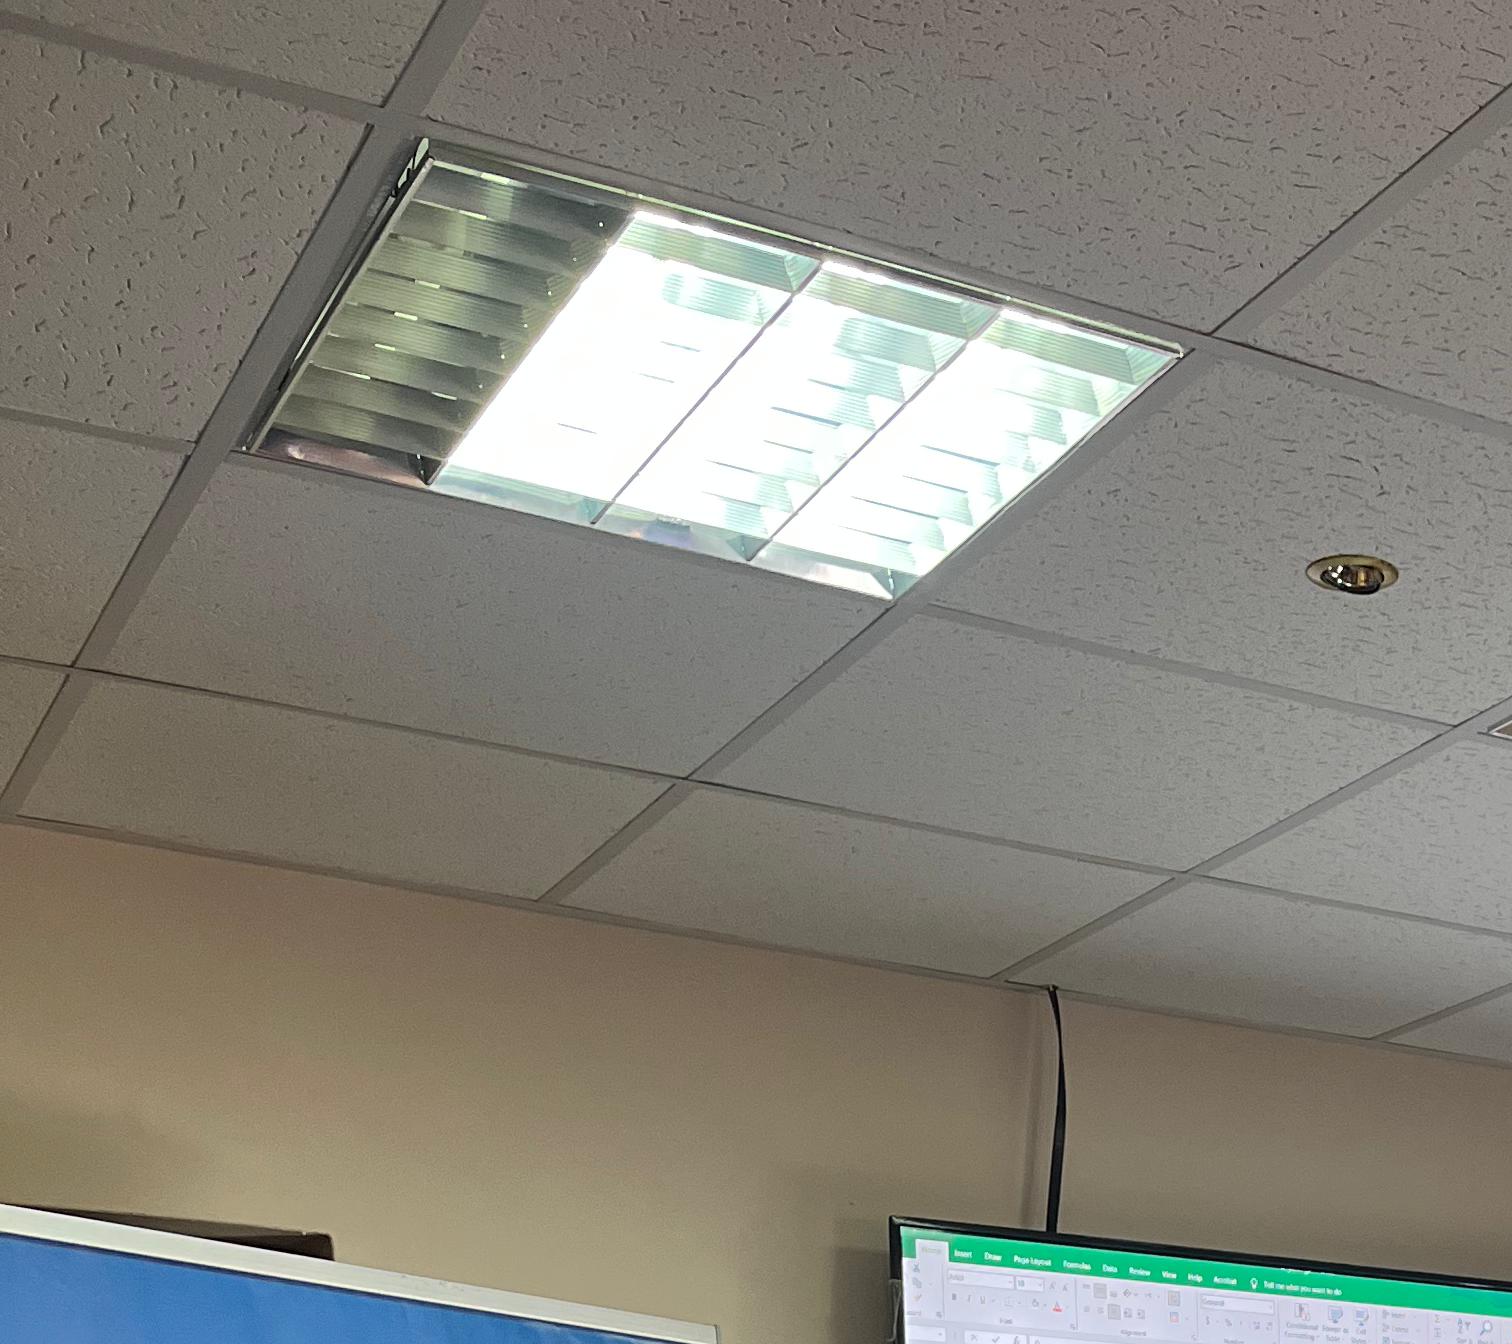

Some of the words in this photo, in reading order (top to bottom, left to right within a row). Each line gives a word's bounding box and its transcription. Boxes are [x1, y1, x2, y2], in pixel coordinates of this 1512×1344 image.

[954, 1249, 973, 1259] Insert
[984, 1252, 1002, 1262] Draw
[1102, 1264, 1118, 1273] Data
[1129, 1267, 1151, 1276] Review
[1162, 1271, 1177, 1279] View
[1187, 1273, 1203, 1283] Help
